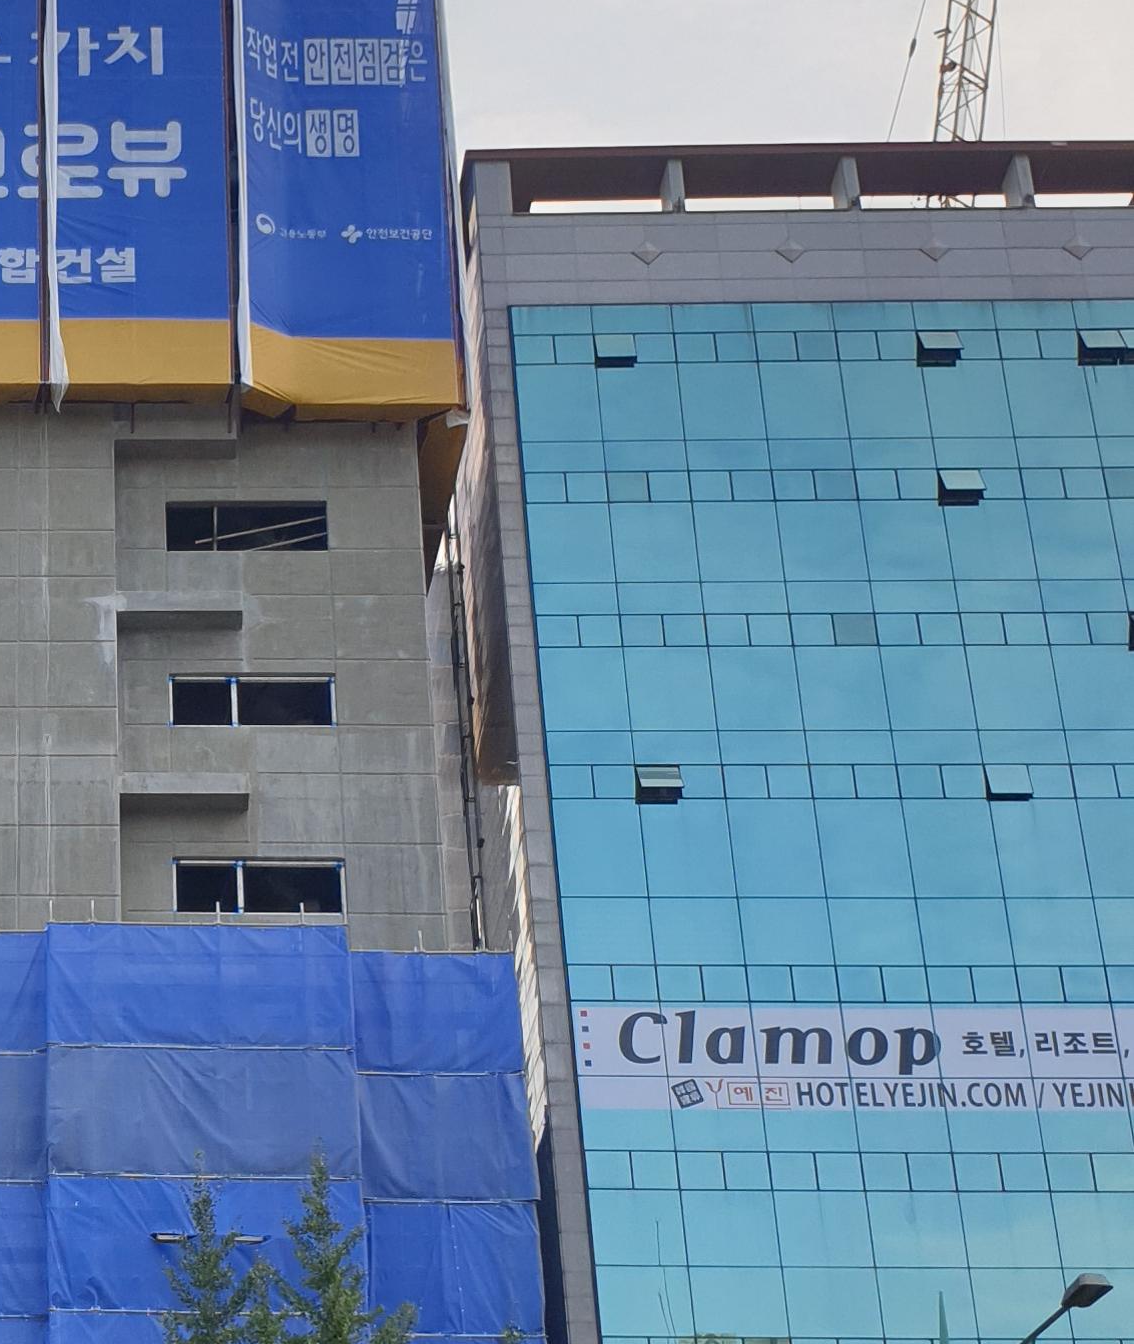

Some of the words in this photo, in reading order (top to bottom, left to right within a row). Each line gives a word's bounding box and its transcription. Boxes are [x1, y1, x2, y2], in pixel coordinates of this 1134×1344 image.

[29, 26, 165, 76] 가치
[250, 97, 303, 154] 당신의
[307, 111, 360, 155] 생명
[366, 227, 433, 240] 안전보건공단
[618, 1010, 942, 1075] Clamop
[961, 1030, 1025, 1059] 호텔,
[1034, 1030, 1130, 1059] 리조트,
[796, 1081, 1027, 1108] HOTELYEJIN.COM
